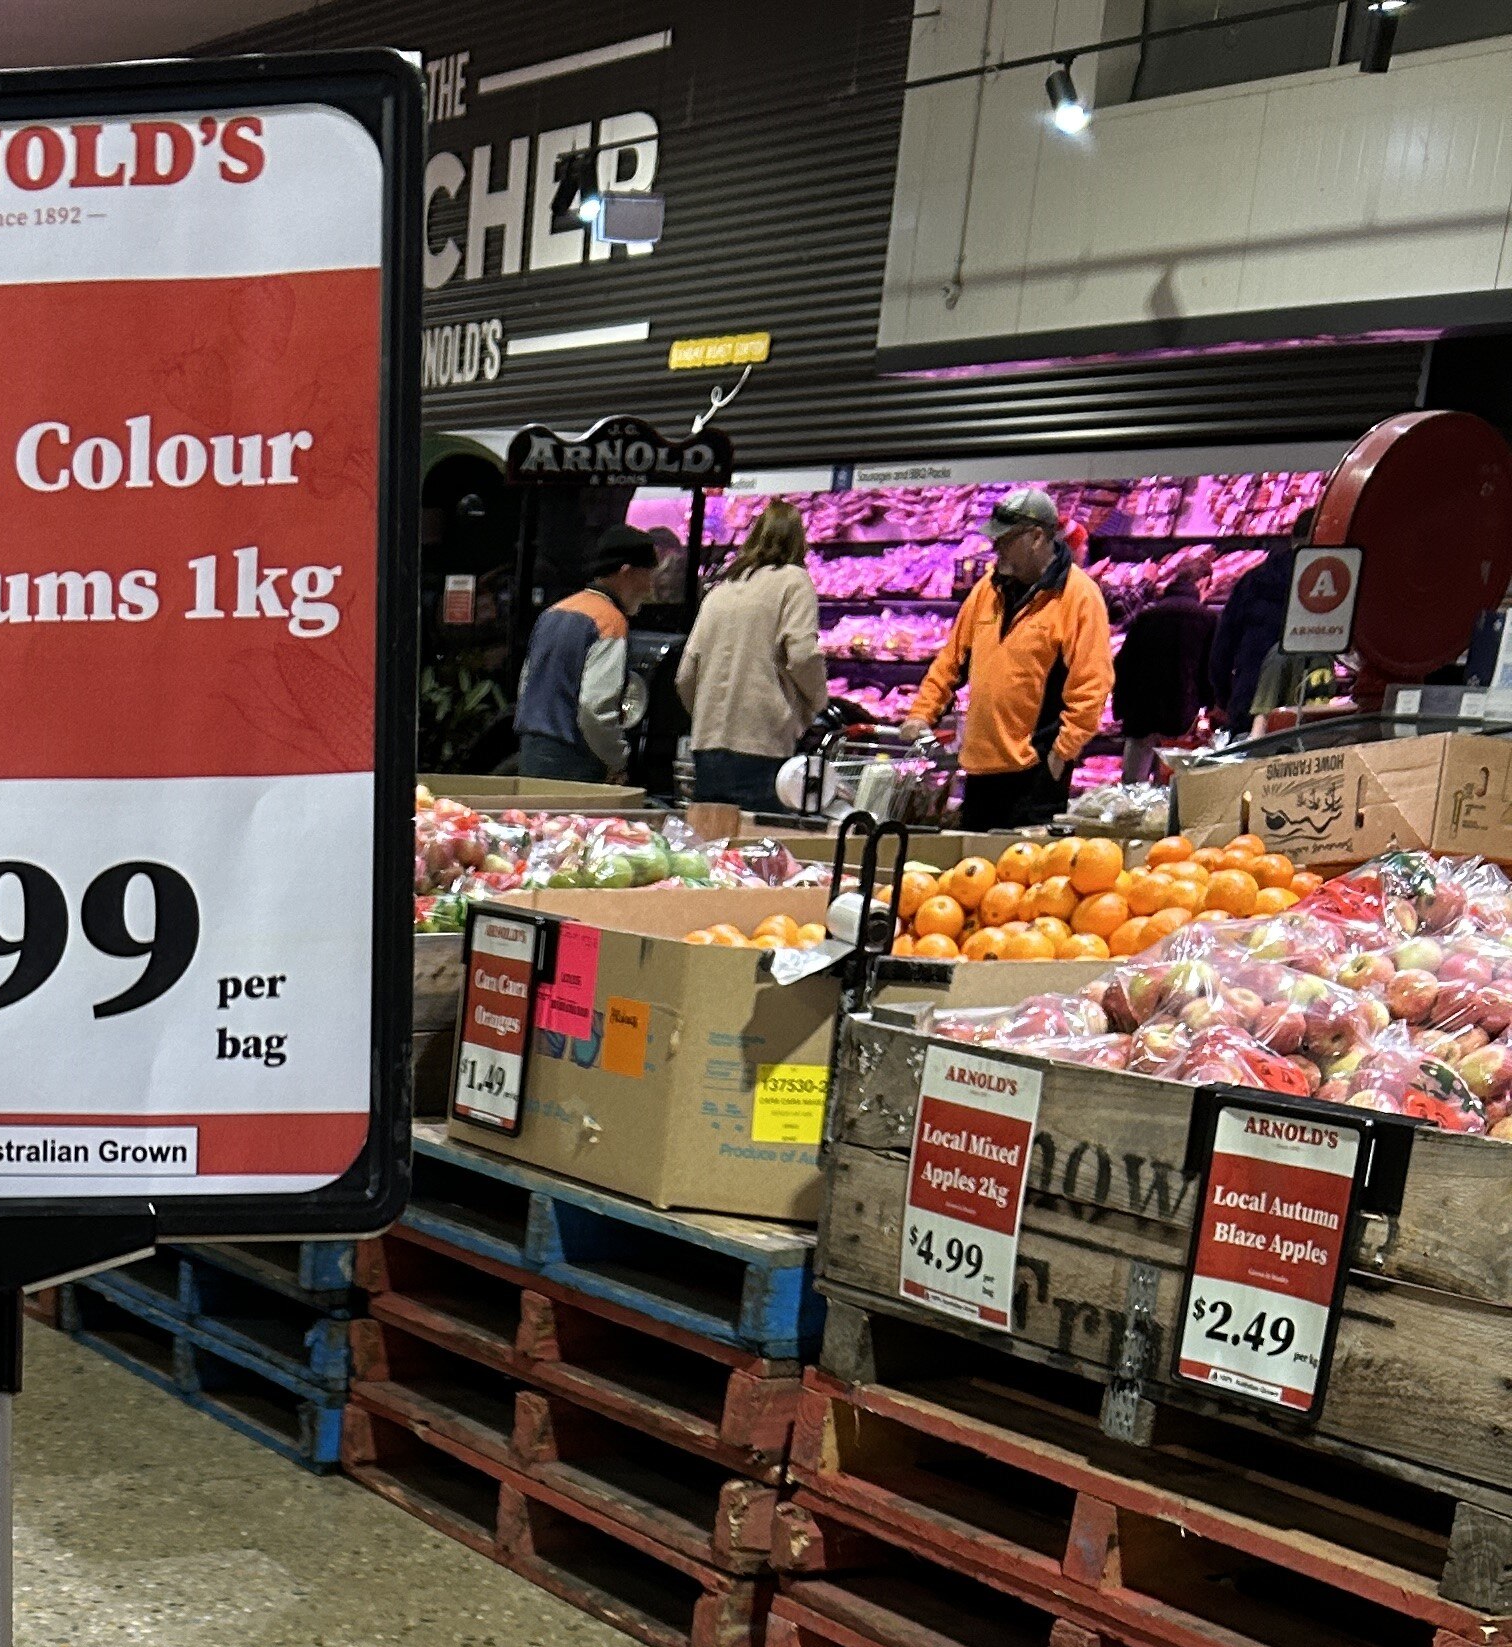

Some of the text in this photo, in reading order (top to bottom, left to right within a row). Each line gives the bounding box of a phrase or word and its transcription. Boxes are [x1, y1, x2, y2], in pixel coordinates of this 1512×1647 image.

[426, 50, 470, 123] THE
[33, 204, 83, 227] 1892
[421, 318, 503, 387] NOLD'S
[16, 415, 313, 492] Colour
[184, 547, 344, 639] 1kg
[217, 970, 287, 1009] per
[215, 1028, 288, 1068] bag
[945, 1065, 1018, 1097] ARNOLD'S
[98, 1138, 188, 1165] Grown
[922, 1121, 1021, 1168] Local Mixed
[1244, 1116, 1339, 1150] ARNOLD'S
[921, 1160, 976, 1194] Apples
[977, 1176, 1011, 1210] 2kg
[1213, 1185, 1339, 1231] Local Autumn
[908, 1224, 984, 1280] $4.99
[1213, 1222, 1329, 1267] Blaze Apples
[1192, 1296, 1296, 1356] $2.49
